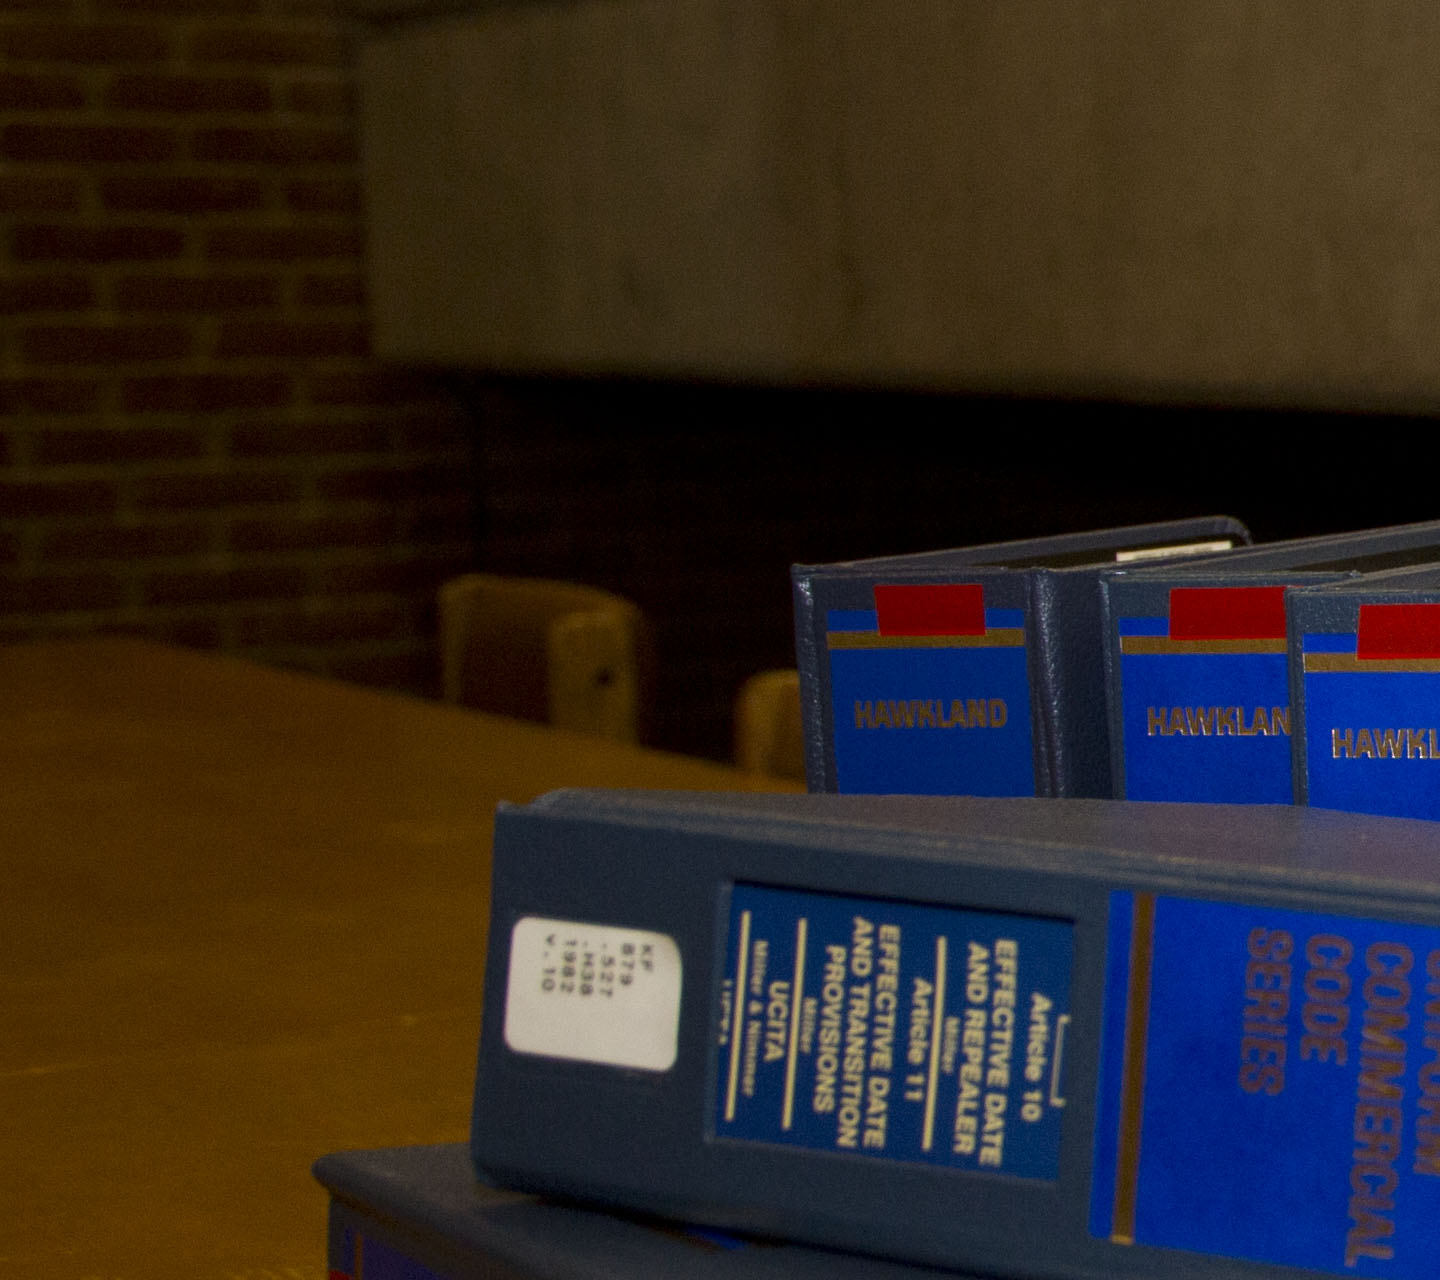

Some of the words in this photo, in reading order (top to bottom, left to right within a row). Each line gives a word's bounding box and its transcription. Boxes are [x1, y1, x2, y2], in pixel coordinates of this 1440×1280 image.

[854, 698, 1008, 730] HAWKLAND
[1147, 706, 1291, 737] HAWKLAN
[640, 943, 654, 973] KF
[849, 917, 875, 977] AND
[964, 941, 989, 1001] AND
[763, 980, 790, 1064] UCITA
[813, 944, 847, 1114] PROVISIONS
[869, 925, 901, 1071] EFFECTIVE
[909, 978, 932, 1064] Article
[985, 938, 1018, 1087] EFFECTIVE
[1024, 994, 1053, 1083] Article
[1238, 926, 1294, 1095] SERIES
[1301, 933, 1354, 1066] CODE
[837, 985, 869, 1148] TRANSITION
[905, 1073, 923, 1103] 11
[953, 1008, 983, 1155] REPEALER
[1020, 1089, 1042, 1122] 10
[1345, 942, 1414, 1267] COMMERCIAL
[864, 1079, 888, 1150] DATE
[979, 1094, 1006, 1166] DATE
